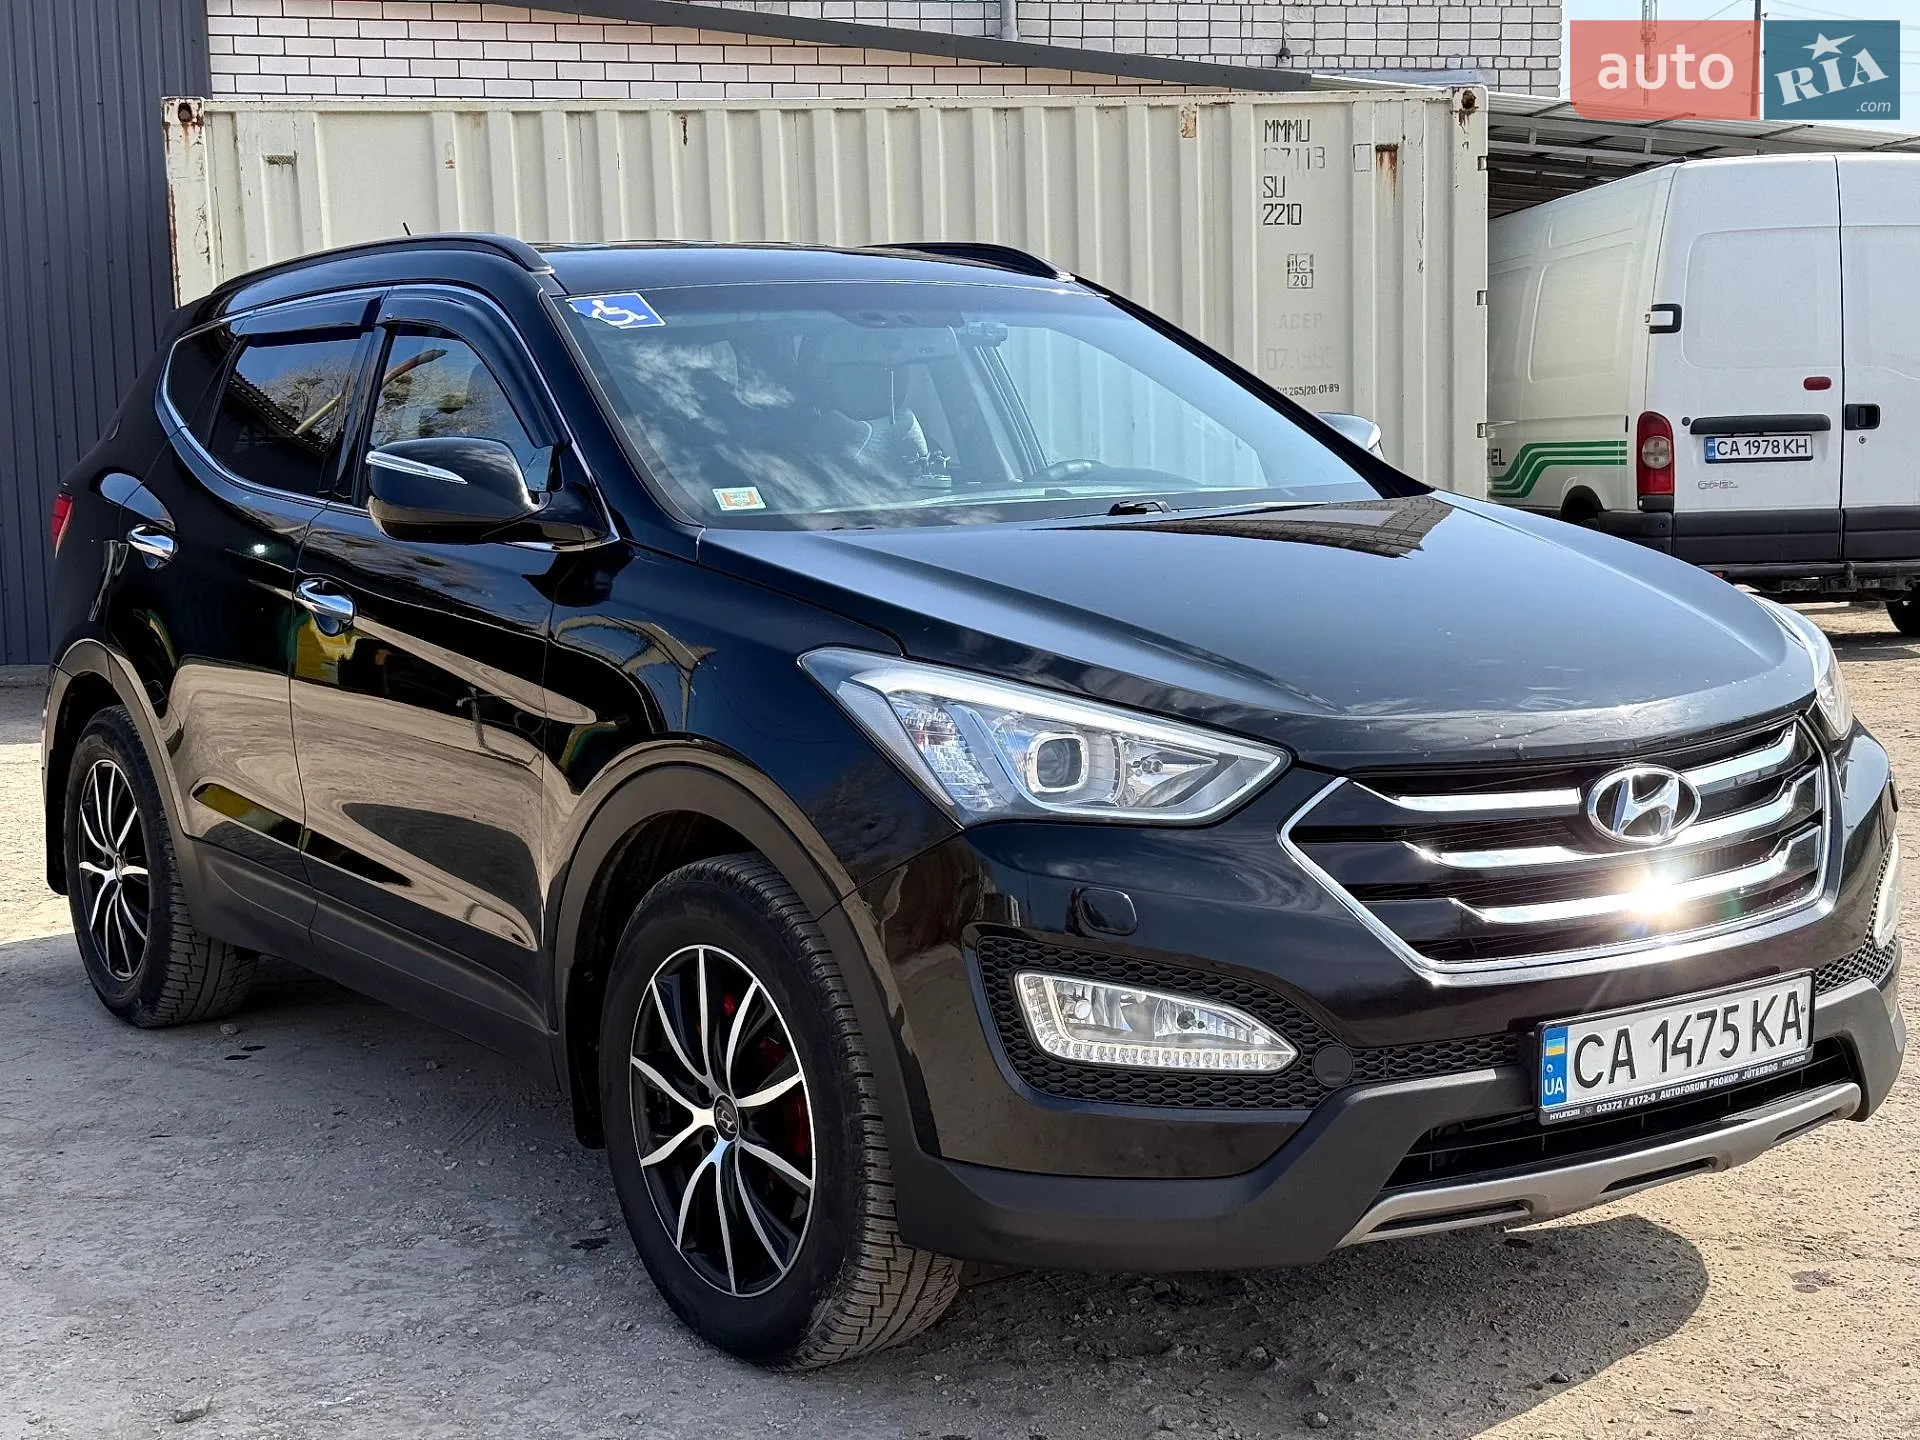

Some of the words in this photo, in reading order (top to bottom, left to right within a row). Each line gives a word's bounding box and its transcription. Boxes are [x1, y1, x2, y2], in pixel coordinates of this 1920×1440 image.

[1264, 119, 1311, 143] MMMU
[1263, 175, 1286, 198] SU
[1263, 203, 1302, 225] 2210
[1292, 274, 1308, 287] 20
[1716, 440, 1741, 456] CA
[1744, 439, 1781, 455] 1978
[1783, 438, 1808, 454] KH
[1573, 1027, 1637, 1090] CA
[1651, 1003, 1740, 1073] 1475
[1751, 989, 1803, 1052] KA
[1544, 1077, 1565, 1096] UA
[1596, 1100, 1623, 1113] 03372
[1629, 1092, 1656, 1105] 4172-0
[1659, 1080, 1708, 1099] AUTOFORUM
[1708, 1072, 1739, 1088] PROKOP
